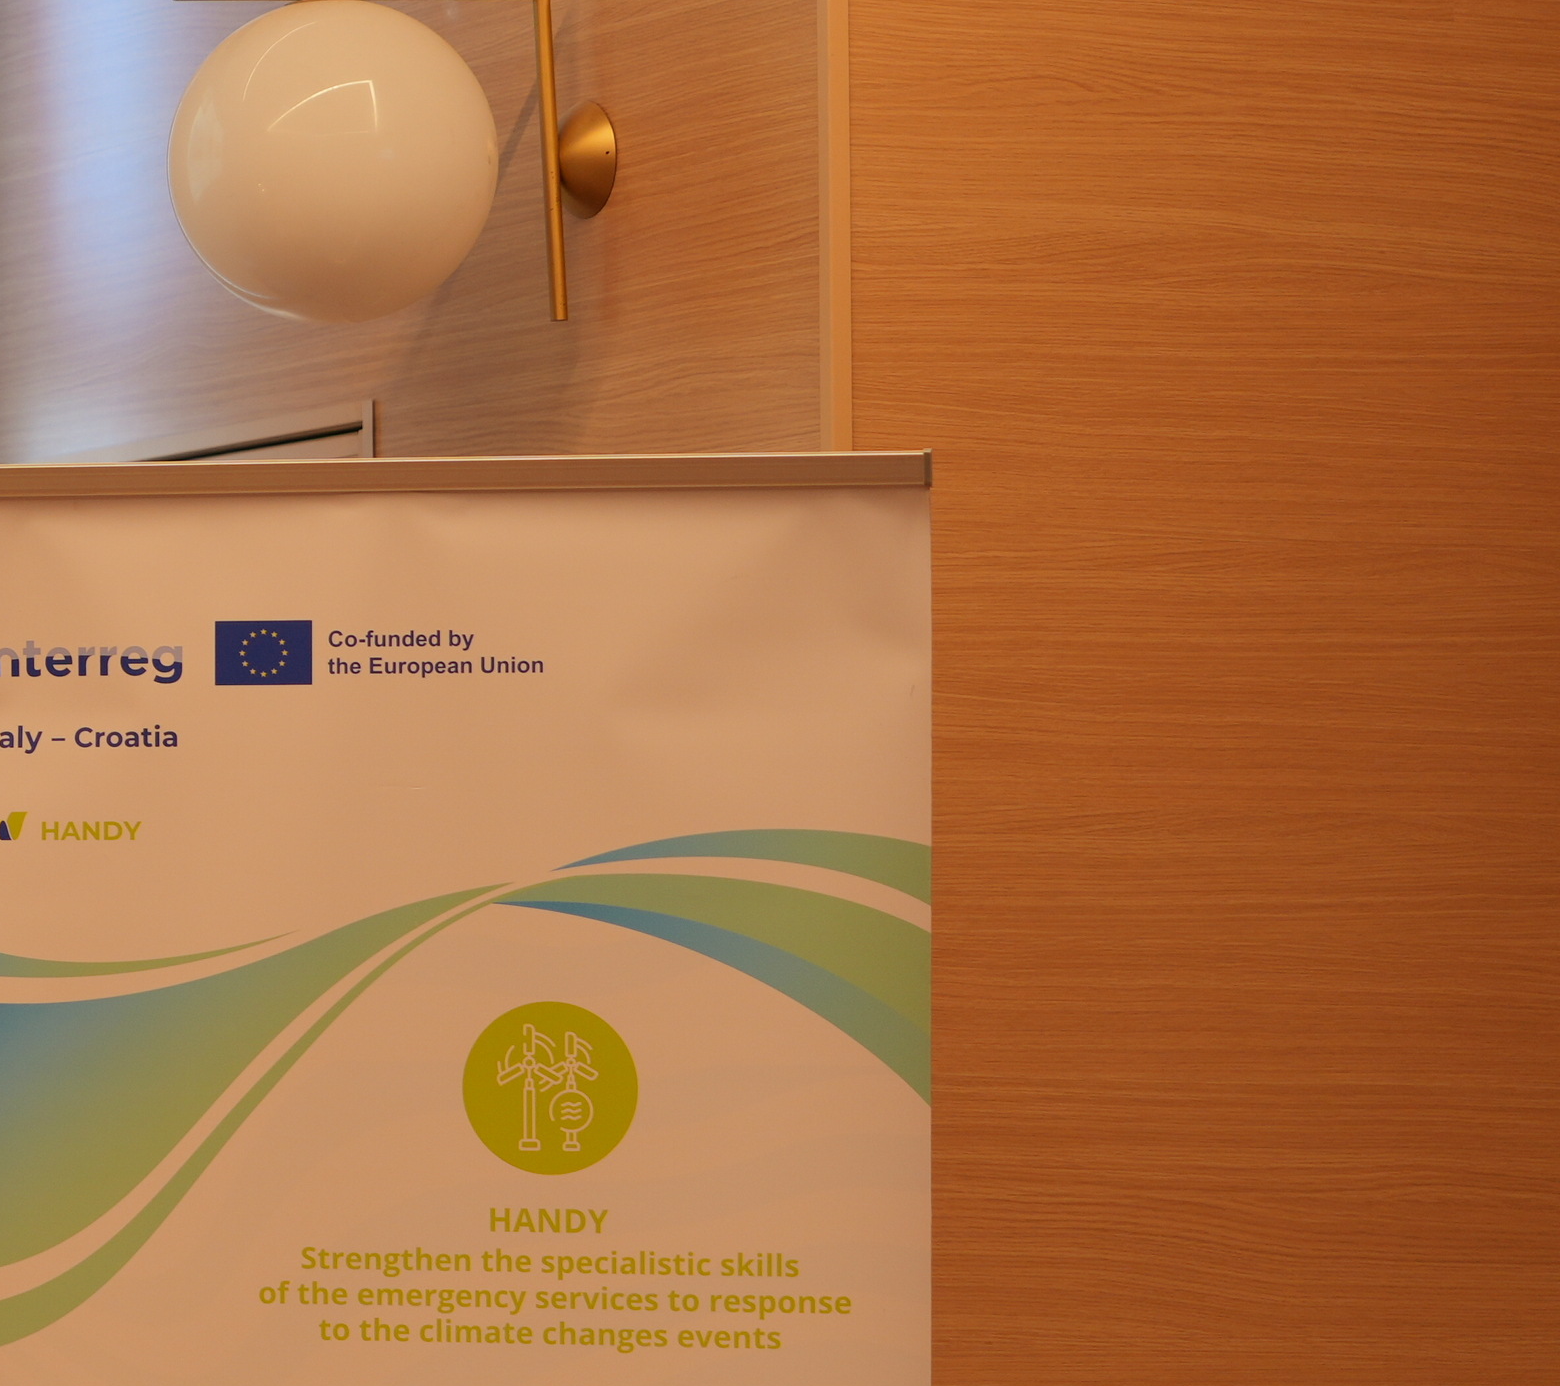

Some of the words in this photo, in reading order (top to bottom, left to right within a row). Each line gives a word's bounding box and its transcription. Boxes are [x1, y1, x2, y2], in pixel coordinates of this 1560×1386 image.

[327, 629, 441, 649] Co-funded
[448, 630, 474, 652] by
[327, 656, 362, 675] the
[369, 656, 474, 678] European
[481, 656, 545, 675] Union
[73, 724, 179, 750] Croatia
[41, 820, 143, 842] HANDY
[488, 1206, 609, 1234] HANDY
[300, 1246, 471, 1278] Strengthen
[481, 1248, 532, 1273] the
[540, 1249, 712, 1281] specialistic
[720, 1252, 800, 1279] skills
[258, 1280, 291, 1305] of
[297, 1281, 348, 1306] the
[357, 1285, 527, 1316] emergency
[535, 1286, 659, 1312] services
[668, 1290, 700, 1313] to
[709, 1291, 852, 1321] response
[318, 1319, 351, 1342] to
[358, 1317, 410, 1343] the
[419, 1318, 533, 1345] climate
[542, 1323, 668, 1353] changes
[677, 1326, 782, 1350] events
